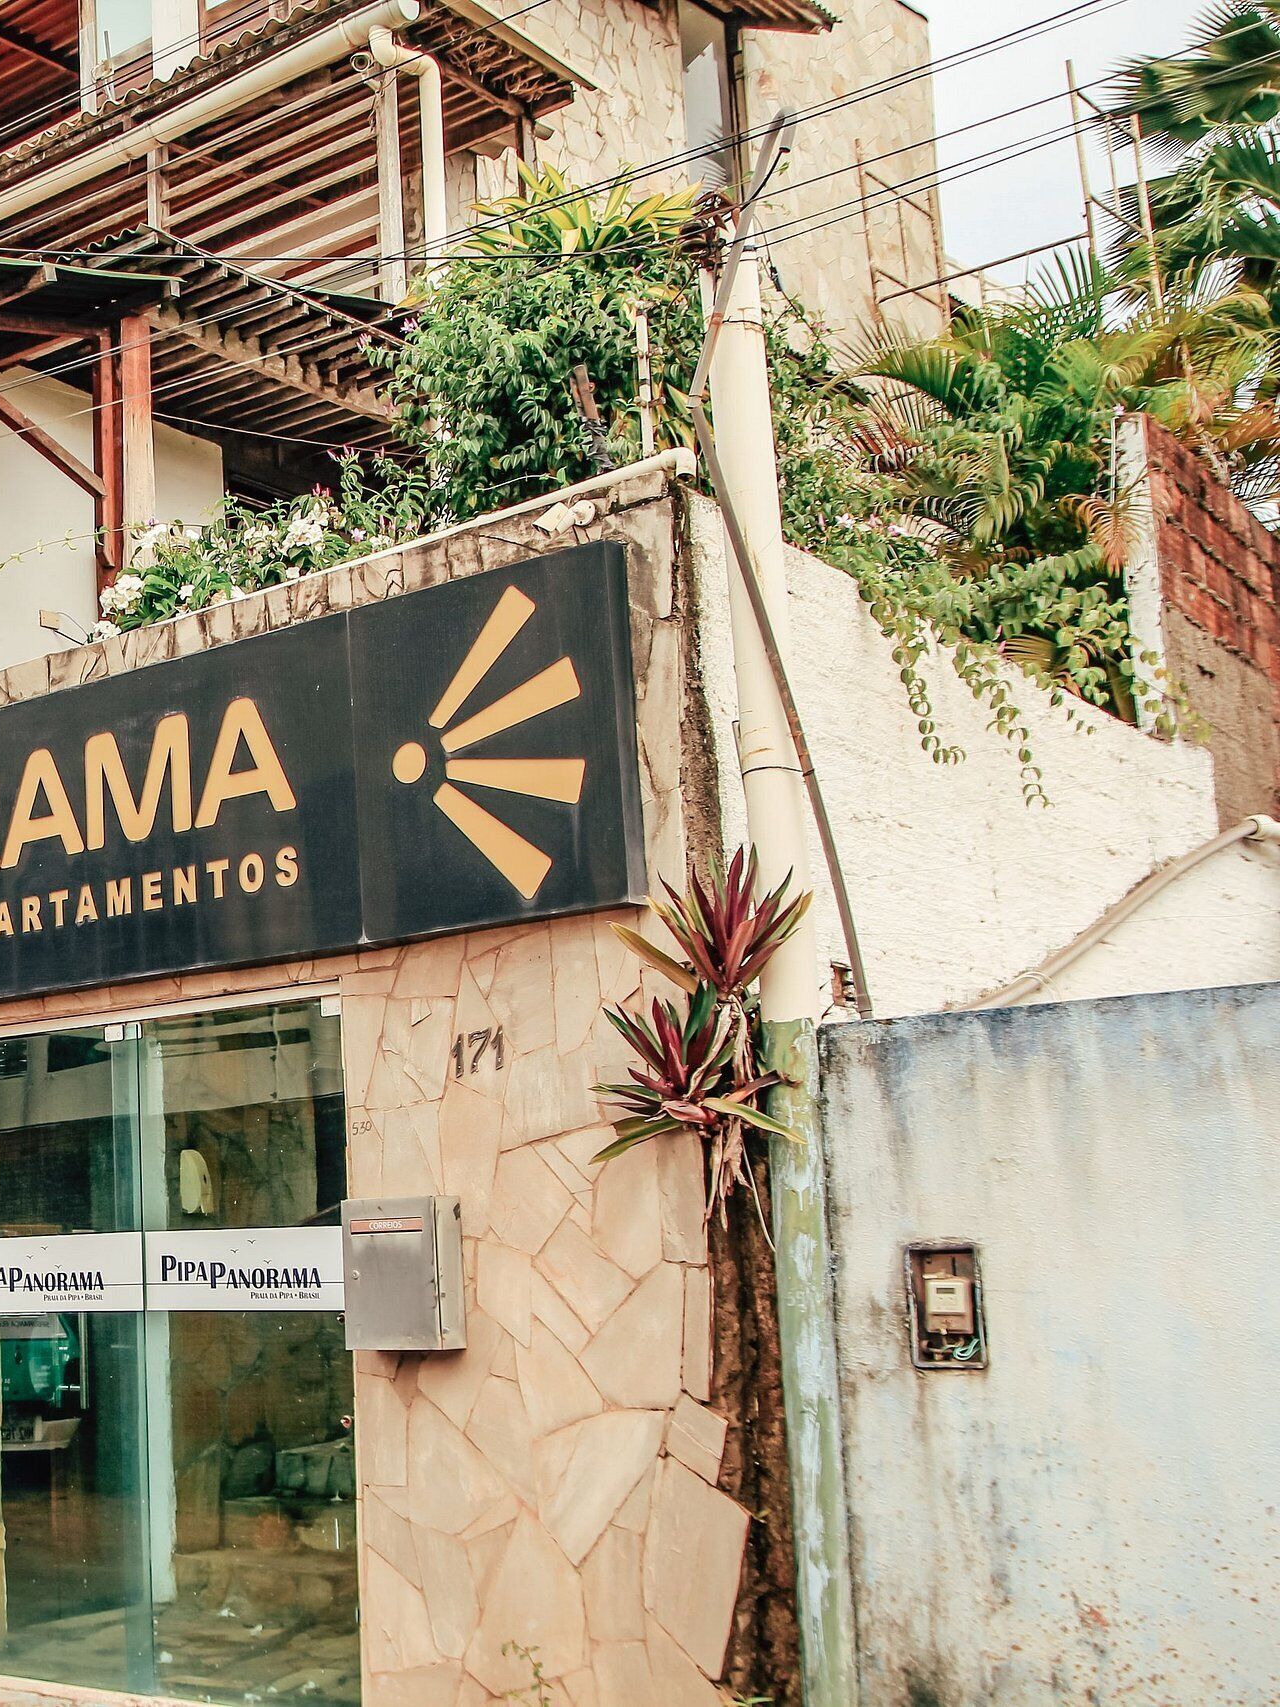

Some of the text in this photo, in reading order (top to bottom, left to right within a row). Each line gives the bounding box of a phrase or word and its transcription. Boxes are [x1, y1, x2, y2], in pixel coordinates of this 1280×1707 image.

[451, 1025, 504, 1079] 171
[352, 1120, 372, 1135] 530
[368, 1220, 403, 1230] CORREIOS
[299, 1291, 320, 1299] BRASIL
